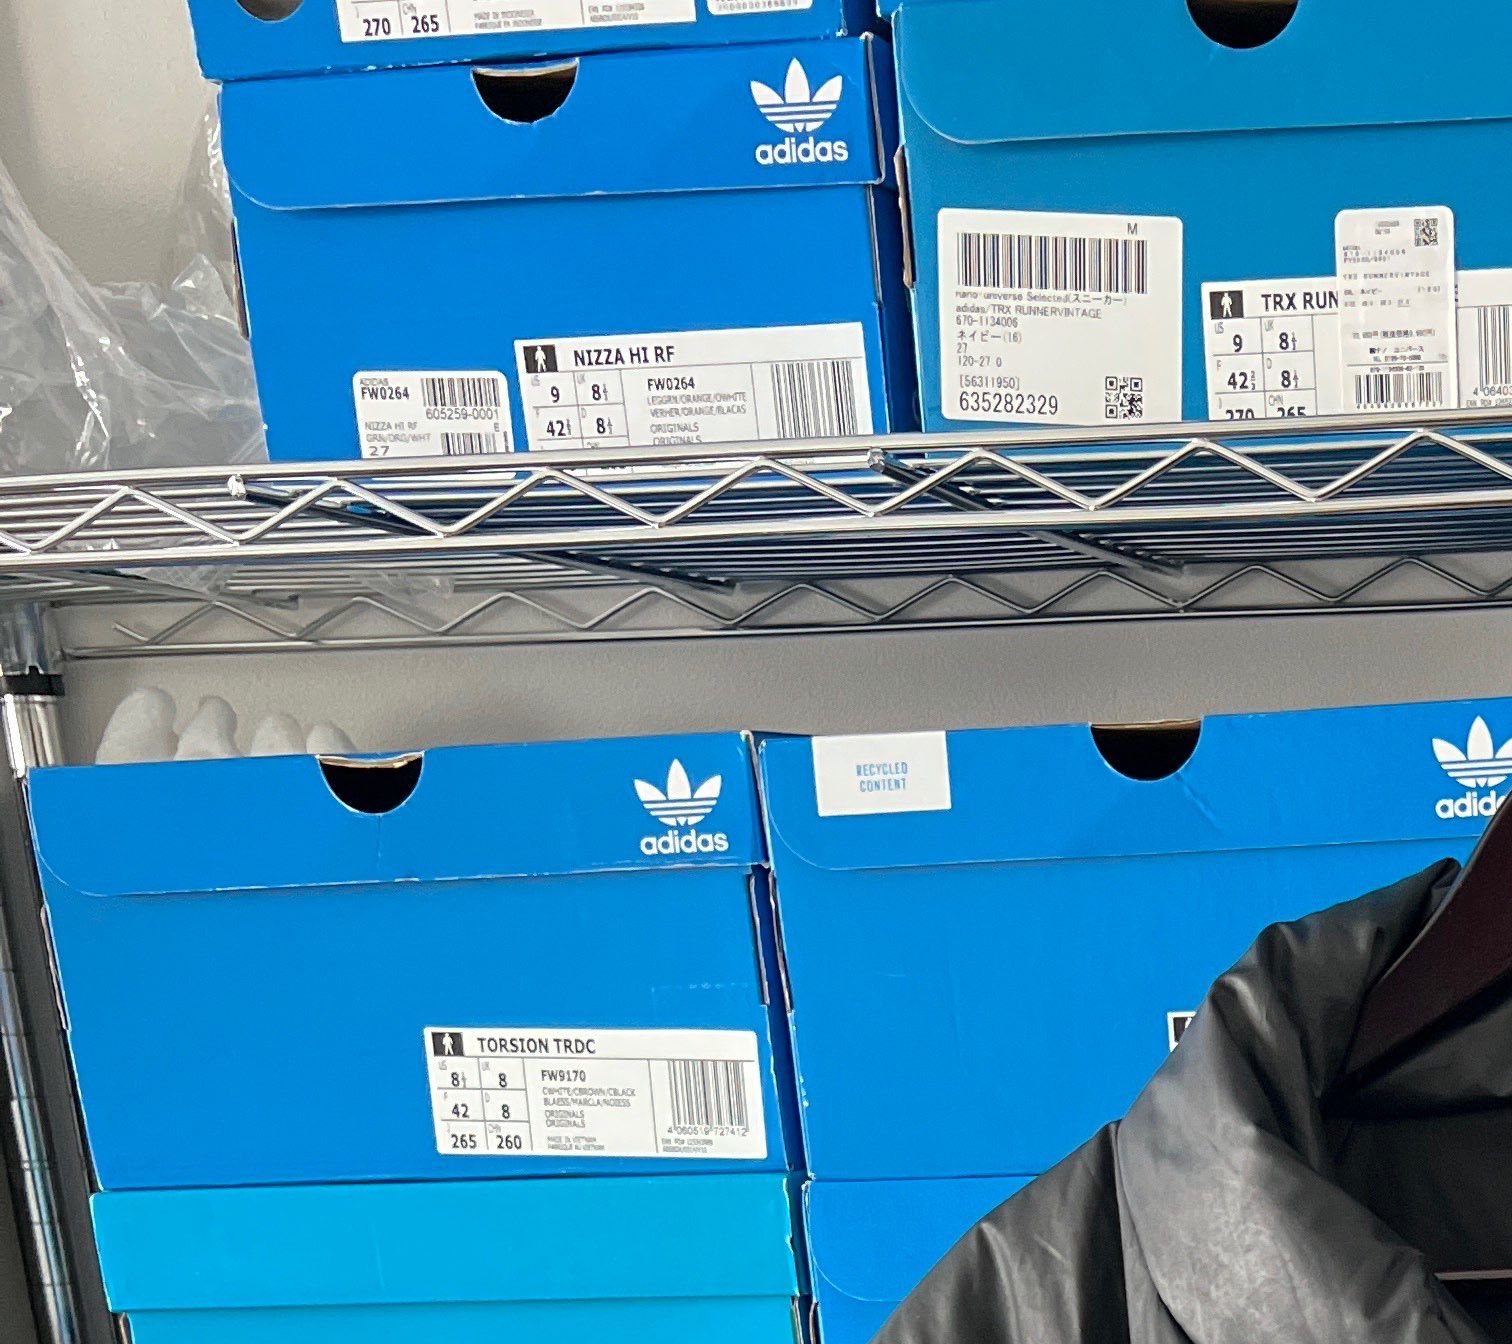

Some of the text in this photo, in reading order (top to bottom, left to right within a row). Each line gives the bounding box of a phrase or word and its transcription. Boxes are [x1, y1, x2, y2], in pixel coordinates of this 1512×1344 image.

[363, 18, 391, 36] 270
[412, 15, 439, 33] 265
[755, 136, 848, 165] adidas
[1128, 223, 1138, 236] M
[1261, 293, 1298, 312] TRX
[1303, 290, 1339, 310] RUN
[1233, 335, 1243, 352] 9
[574, 346, 675, 367] NIZZA HI RF
[647, 377, 695, 391] FW0264
[361, 386, 410, 400] FW0264
[551, 386, 561, 402] 9
[960, 392, 1058, 415] 635282329
[426, 408, 499, 421] 605259-0001
[856, 761, 908, 777] RECYCLED
[859, 777, 907, 793] CONTENT
[1435, 790, 1506, 819] adid
[640, 829, 729, 855] adidas
[477, 1037, 596, 1054] TORSION TRDC
[498, 1073, 507, 1088] 8
[541, 1069, 586, 1083] FW9170
[452, 1104, 470, 1118] 42
[501, 1104, 510, 1119] 8
[451, 1134, 477, 1149] 265
[497, 1135, 522, 1149] 260
